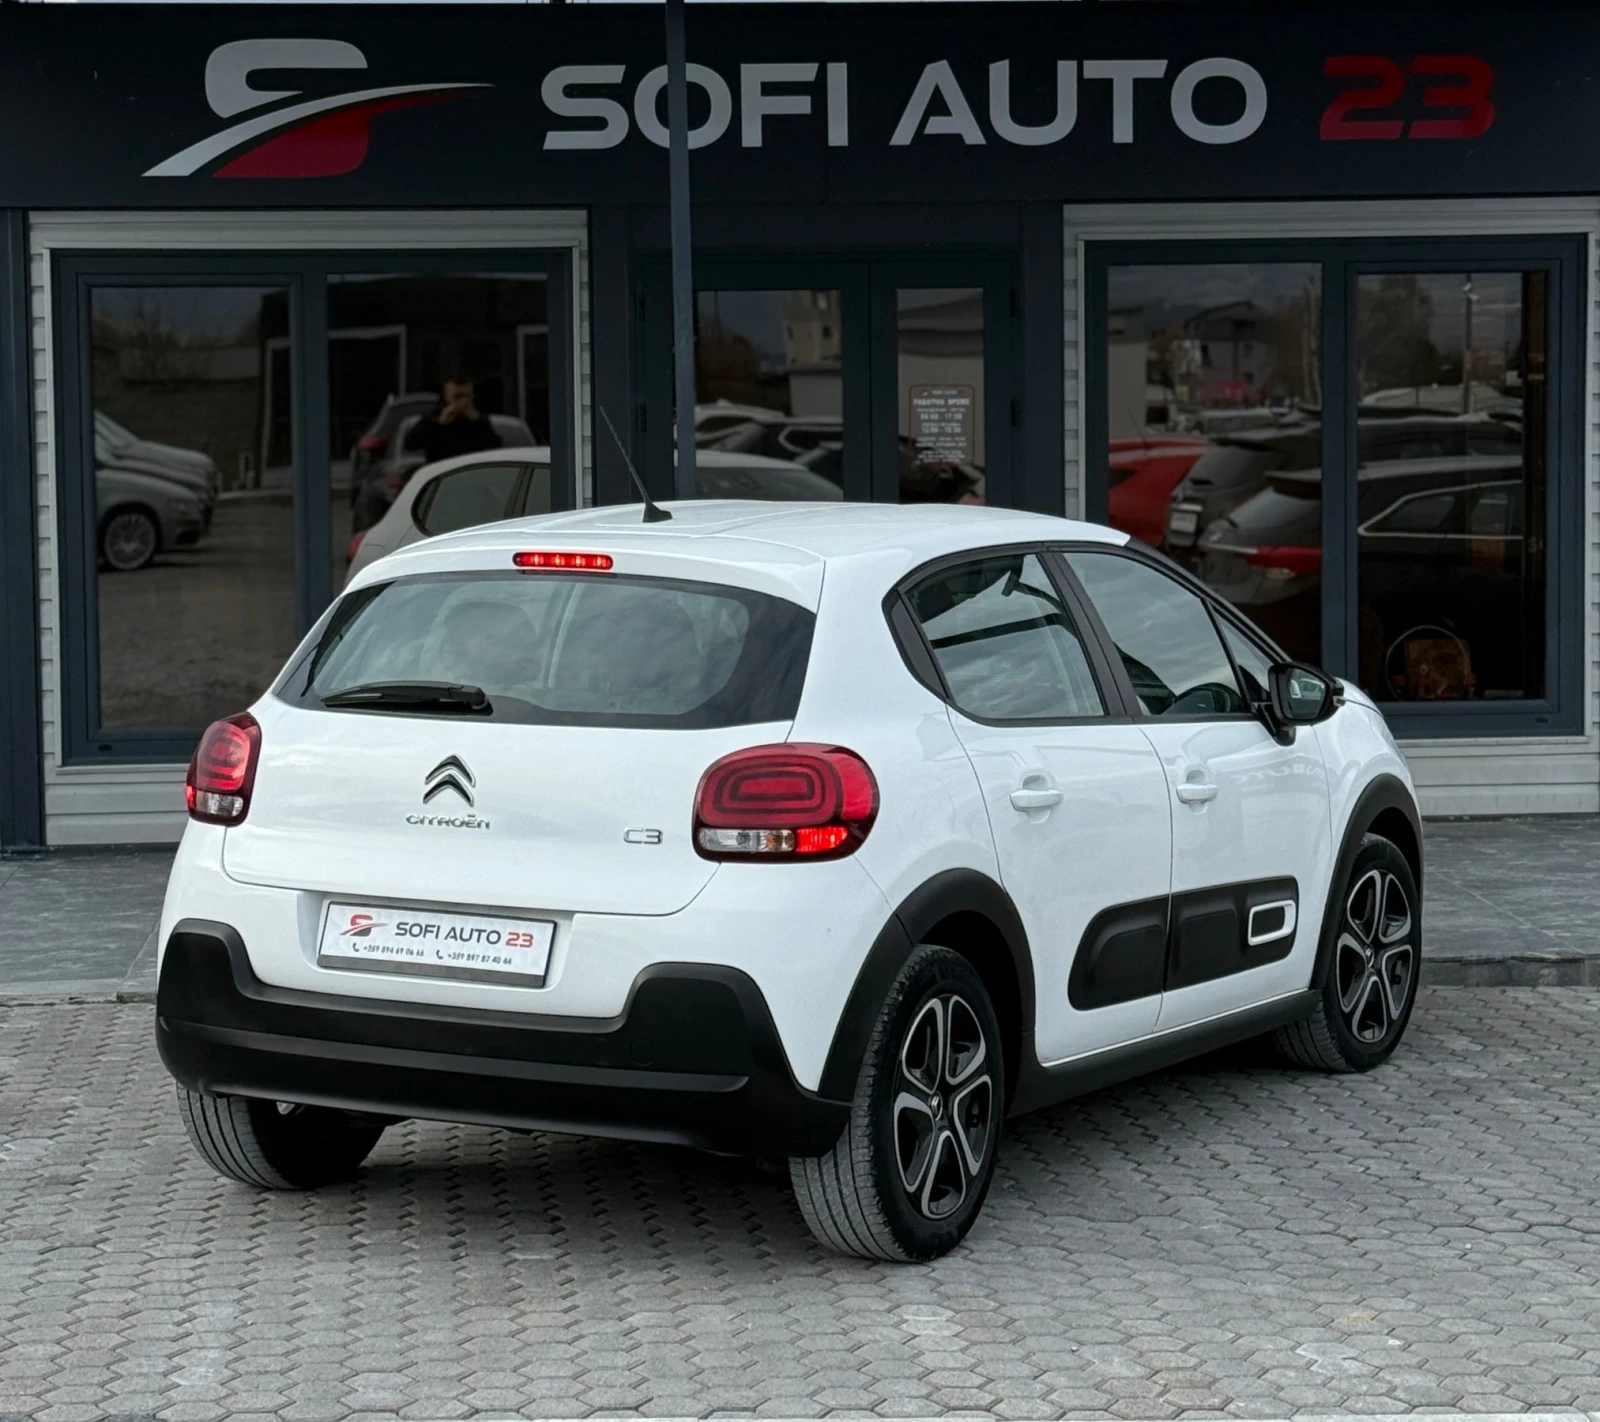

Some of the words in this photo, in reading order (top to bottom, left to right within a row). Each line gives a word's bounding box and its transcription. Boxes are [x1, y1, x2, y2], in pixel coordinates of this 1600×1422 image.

[541, 62, 849, 150] SOFI
[889, 57, 1268, 146] AUTO
[1320, 54, 1496, 141] 23
[623, 827, 663, 845] C3
[395, 921, 441, 939] SOFI
[444, 927, 501, 945] AUTO
[505, 931, 534, 948] 23
